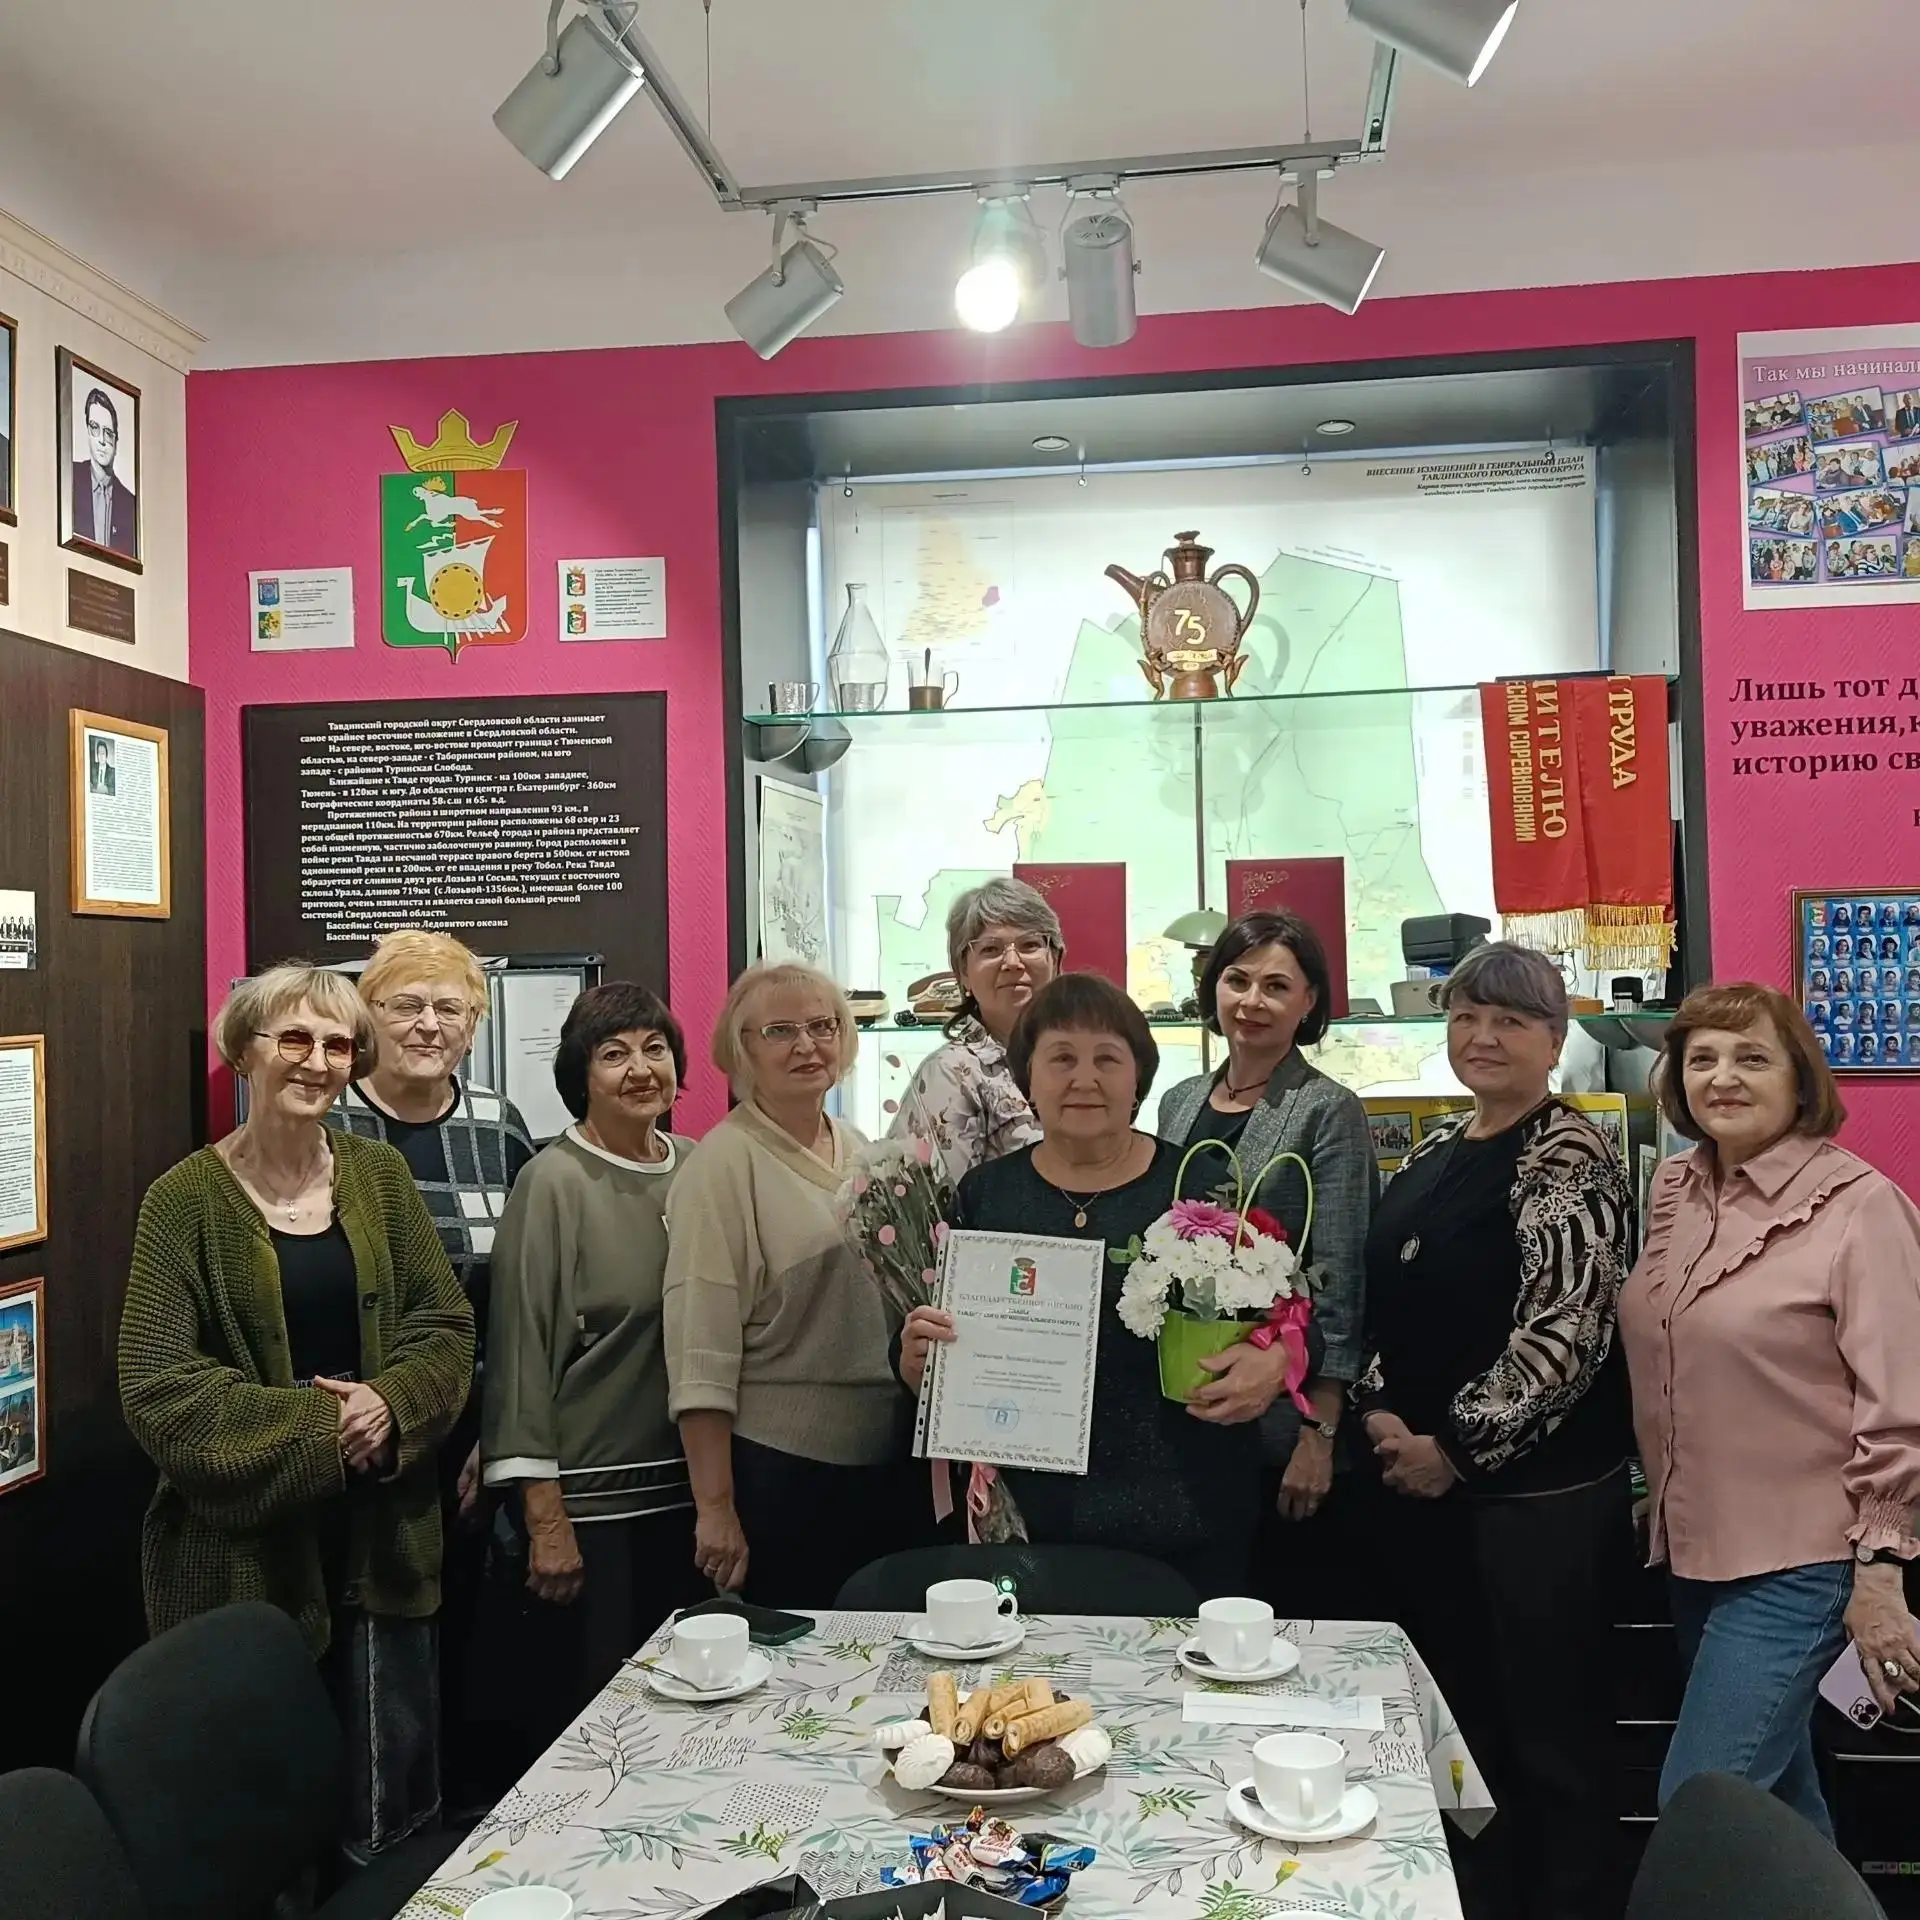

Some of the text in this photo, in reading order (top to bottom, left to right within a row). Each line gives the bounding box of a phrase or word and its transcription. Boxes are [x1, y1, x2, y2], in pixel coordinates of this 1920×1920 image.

[1753, 365, 1790, 382] Так
[1796, 366, 1826, 380] мы
[1366, 467, 1416, 476] ВНЕСЕНИЕ
[1417, 462, 1477, 474] ИЗМЕНЕНИЙ
[1478, 462, 1485, 470] В
[1557, 455, 1584, 465] ПЛАН
[1421, 462, 1585, 481] ТАВДИНСКОГО ГОРОДСКОГО ОКРУГА
[1174, 609, 1206, 645] 75
[1729, 678, 1826, 702] Лишь
[1834, 678, 1889, 698] тот
[328, 719, 382, 730] Тавдинский
[383, 718, 429, 730] городской
[431, 719, 457, 728] округ
[458, 716, 521, 728] Свердловской
[523, 715, 560, 724] области
[327, 731, 365, 743] крайнее
[366, 732, 413, 740] восточное
[473, 727, 537, 739] Свердловской
[413, 741, 469, 749] юго-востоке
[470, 740, 513, 749] проходит
[514, 739, 552, 748] граница
[561, 735, 612, 745] Тюменской
[1608, 687, 1638, 790] ТРУДА
[358, 754, 422, 764] северо-западе
[436, 750, 496, 762] Таборинским
[300, 768, 331, 776] западе
[343, 764, 383, 776] районом
[385, 763, 432, 774] Туринская
[1732, 753, 1878, 780] историю
[328, 775, 383, 785] Ближайшие
[391, 774, 418, 784] Тавде
[455, 772, 492, 783] Туринск
[512, 771, 541, 780] 100км
[300, 787, 336, 797] Тюмень
[350, 786, 378, 795] 120км
[422, 784, 474, 793] областного
[475, 785, 507, 794] центра
[516, 781, 580, 793] Екатеринбург
[586, 780, 616, 789] 360км
[1509, 730, 1537, 843] СОРЕВНОВАНИИ
[301, 798, 430, 810] Географические координаты
[327, 808, 397, 820] Протяженность
[398, 807, 431, 818] района
[439, 808, 487, 817] широтном
[488, 807, 549, 816] направлении
[301, 822, 363, 832] меридианном
[410, 820, 464, 829] территории
[465, 817, 499, 828] района
[500, 817, 563, 827] расположены
[576, 816, 599, 825] озер
[301, 834, 323, 842] реки
[324, 831, 354, 841] общей
[356, 832, 432, 841] протяженностью
[466, 828, 499, 839] Рельеф
[501, 829, 532, 838] города
[542, 827, 575, 837] района
[576, 827, 638, 837] представляет
[301, 843, 327, 852] собой
[426, 839, 492, 851] заболоченную
[535, 838, 562, 849] Город
[563, 839, 619, 848] расположен
[301, 854, 330, 863] пойме
[331, 855, 353, 864] реки
[354, 853, 381, 863] Тавда
[394, 852, 437, 861] песчаной
[438, 853, 474, 862] террасе
[475, 852, 512, 861] правого
[513, 850, 544, 860] берега
[301, 864, 362, 875] одноименной
[363, 866, 386, 874] реки
[458, 864, 502, 872] впадения
[511, 863, 533, 872] реку
[565, 860, 587, 869] Река
[590, 860, 615, 870] Тавда
[301, 876, 351, 887] образуется
[403, 876, 425, 885] двух
[444, 873, 476, 882] Лозьва
[519, 874, 559, 883] текущих
[364, 888, 400, 896] длиною
[401, 885, 430, 894] 719км
[529, 885, 573, 893] имеющая
[576, 882, 604, 891] более
[474, 895, 502, 904] самой
[504, 894, 545, 903] большой
[547, 894, 580, 905] речной
[301, 909, 343, 918] системой
[345, 909, 408, 919] Свердловской
[373, 919, 420, 930] Северного
[423, 918, 474, 929] Ледовитого
[326, 932, 370, 941] Бассейны
